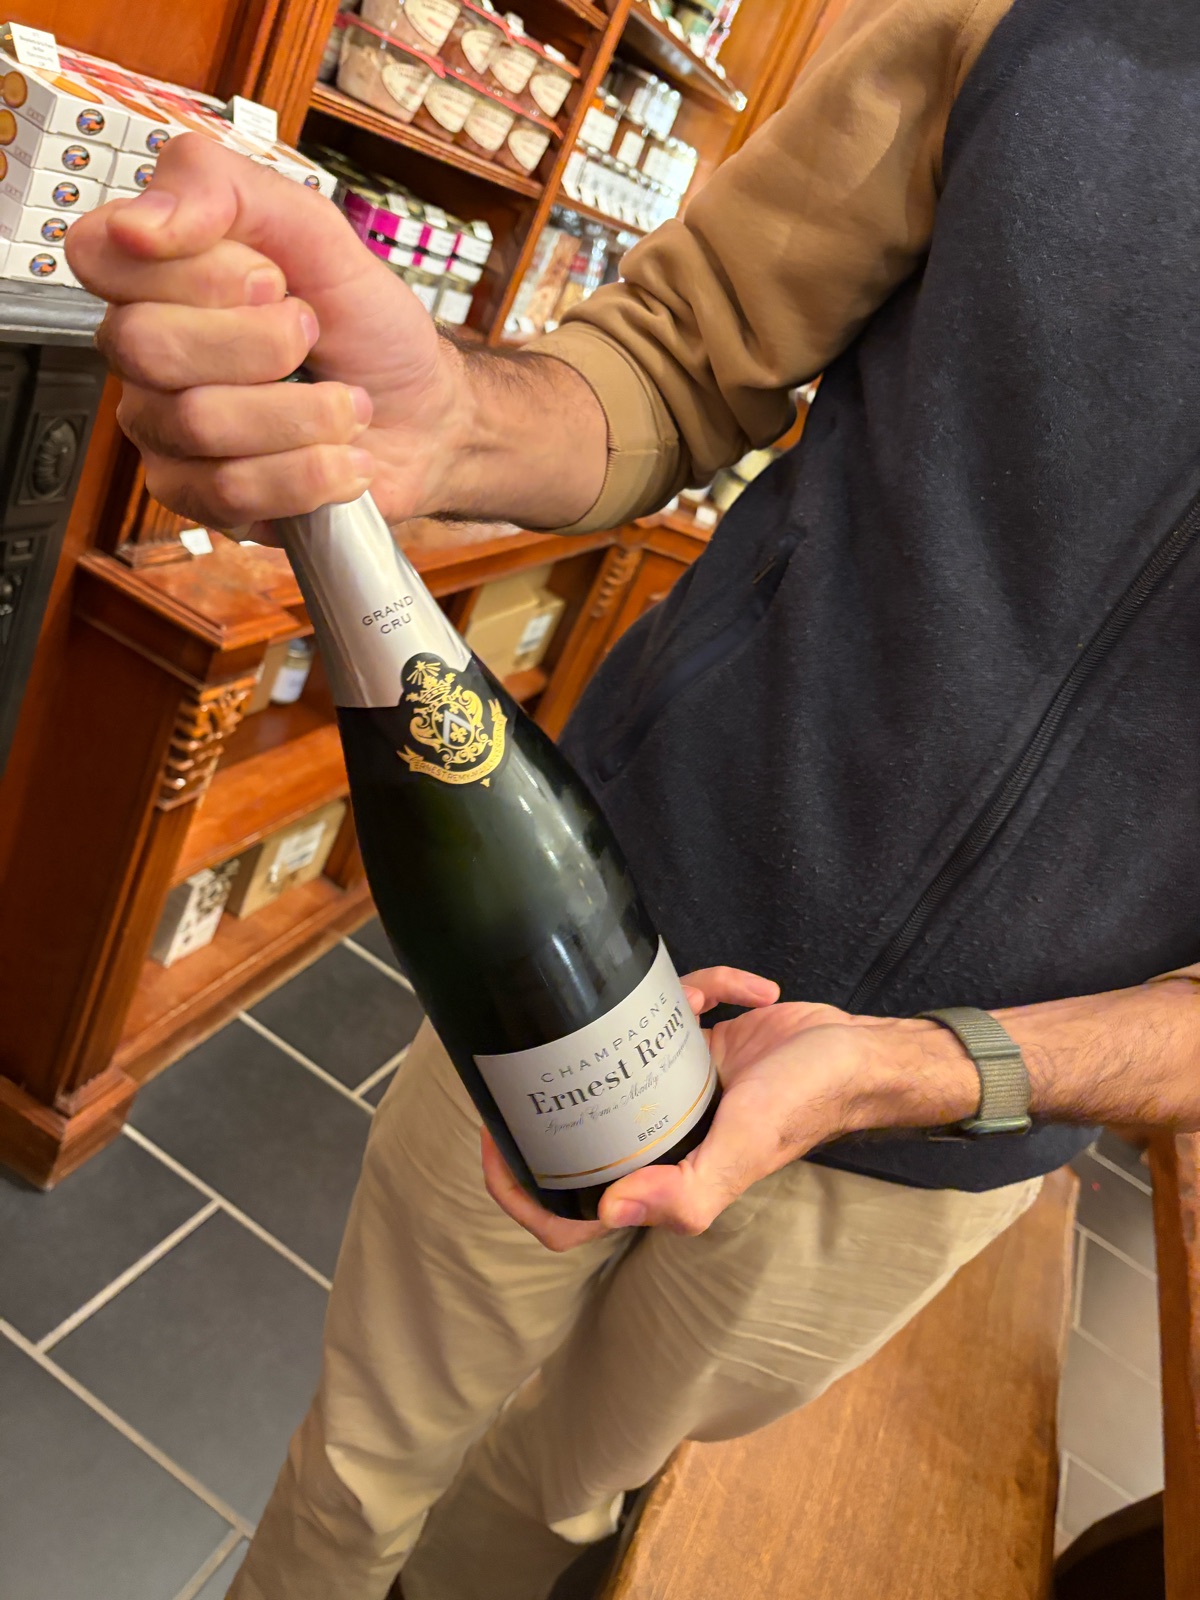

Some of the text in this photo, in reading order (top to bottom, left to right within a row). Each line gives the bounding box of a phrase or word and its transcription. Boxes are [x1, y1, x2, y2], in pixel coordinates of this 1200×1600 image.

[362, 595, 414, 626] GRAND
[380, 613, 412, 634] CRU
[540, 992, 668, 1083] CHAMPAGNE
[527, 1058, 633, 1115] Ernest
[634, 1000, 685, 1068] Remy
[637, 1114, 670, 1142] BRUT
